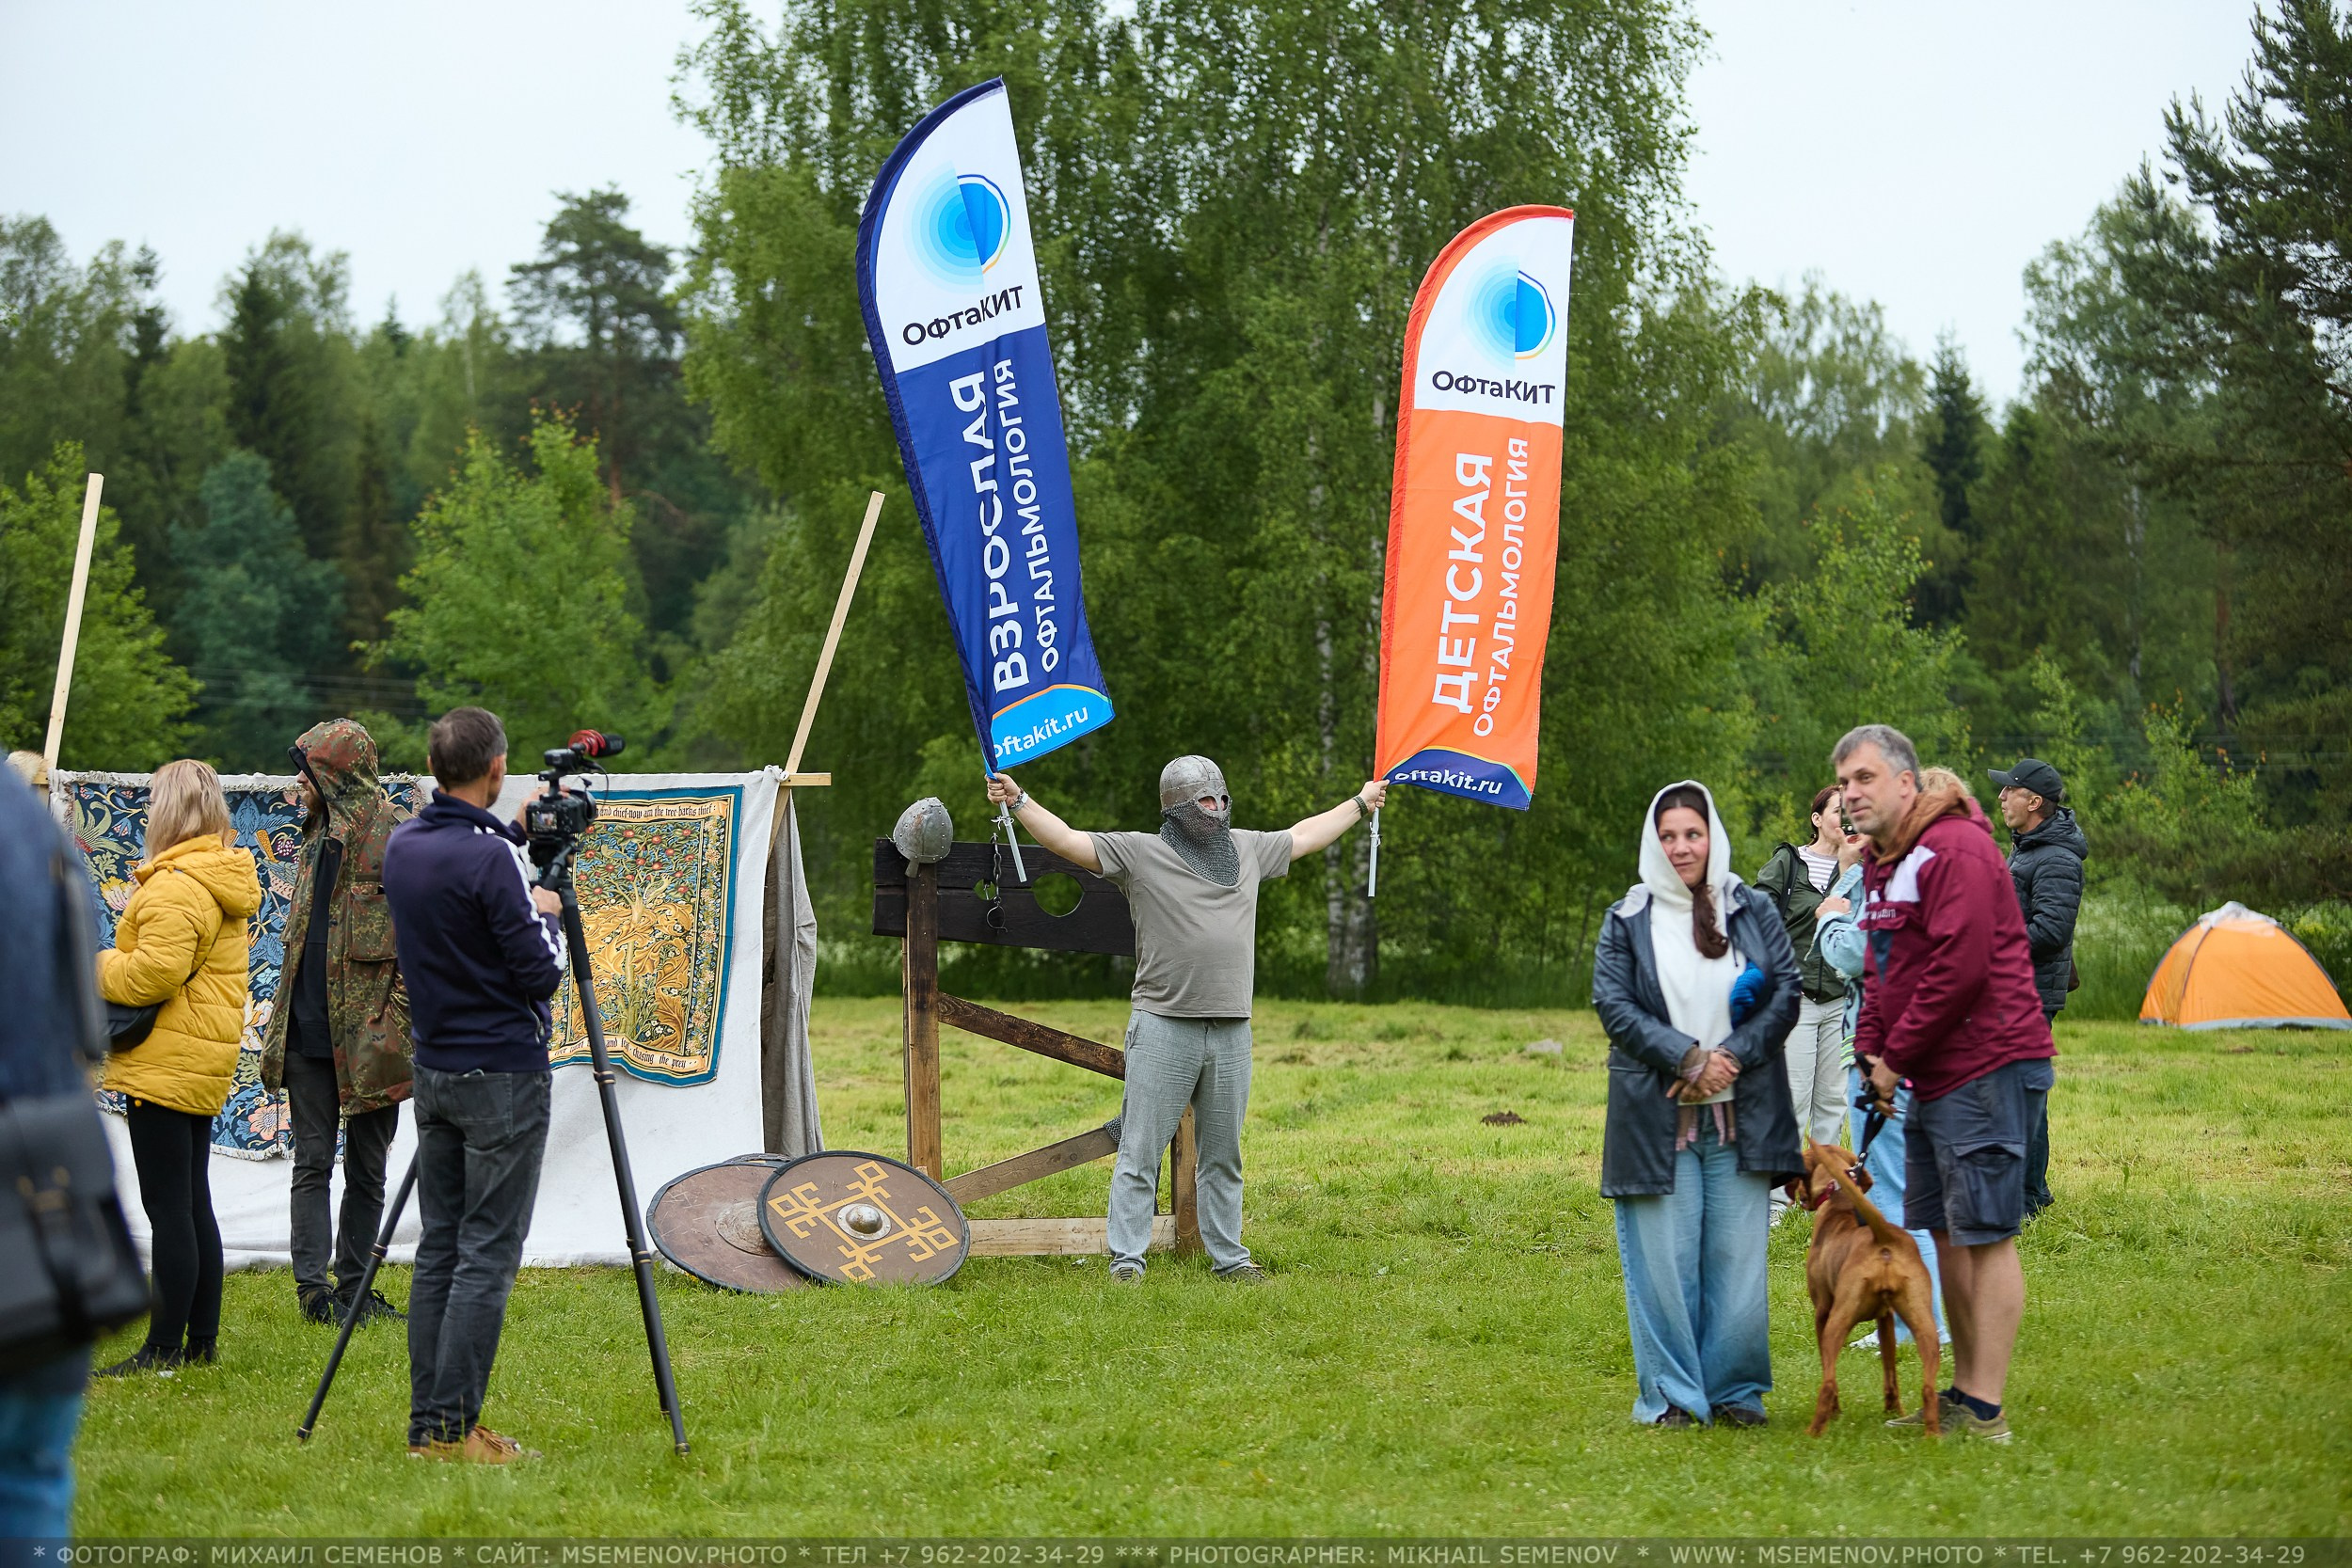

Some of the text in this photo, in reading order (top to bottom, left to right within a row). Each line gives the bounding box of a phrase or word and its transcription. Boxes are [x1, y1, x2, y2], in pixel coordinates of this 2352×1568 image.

[902, 285, 1024, 346] ОфтаКИТ
[1432, 370, 1556, 404] ОфтаКИТ
[948, 372, 1030, 694] ВЗРОСЛАЯ
[993, 358, 1059, 673] ОФТАЛЬМОЛОГИЯ
[1431, 452, 1494, 715] ДЕТСКАЯ
[1472, 437, 1529, 737] ОФТАЛЬМОЛОГИЯ
[993, 706, 1089, 758] oftakit.ru
[1394, 769, 1503, 795] oftakit.ru
[605, 1037, 618, 1048] and
[632, 1047, 655, 1065] chasing
[659, 1053, 670, 1065] the
